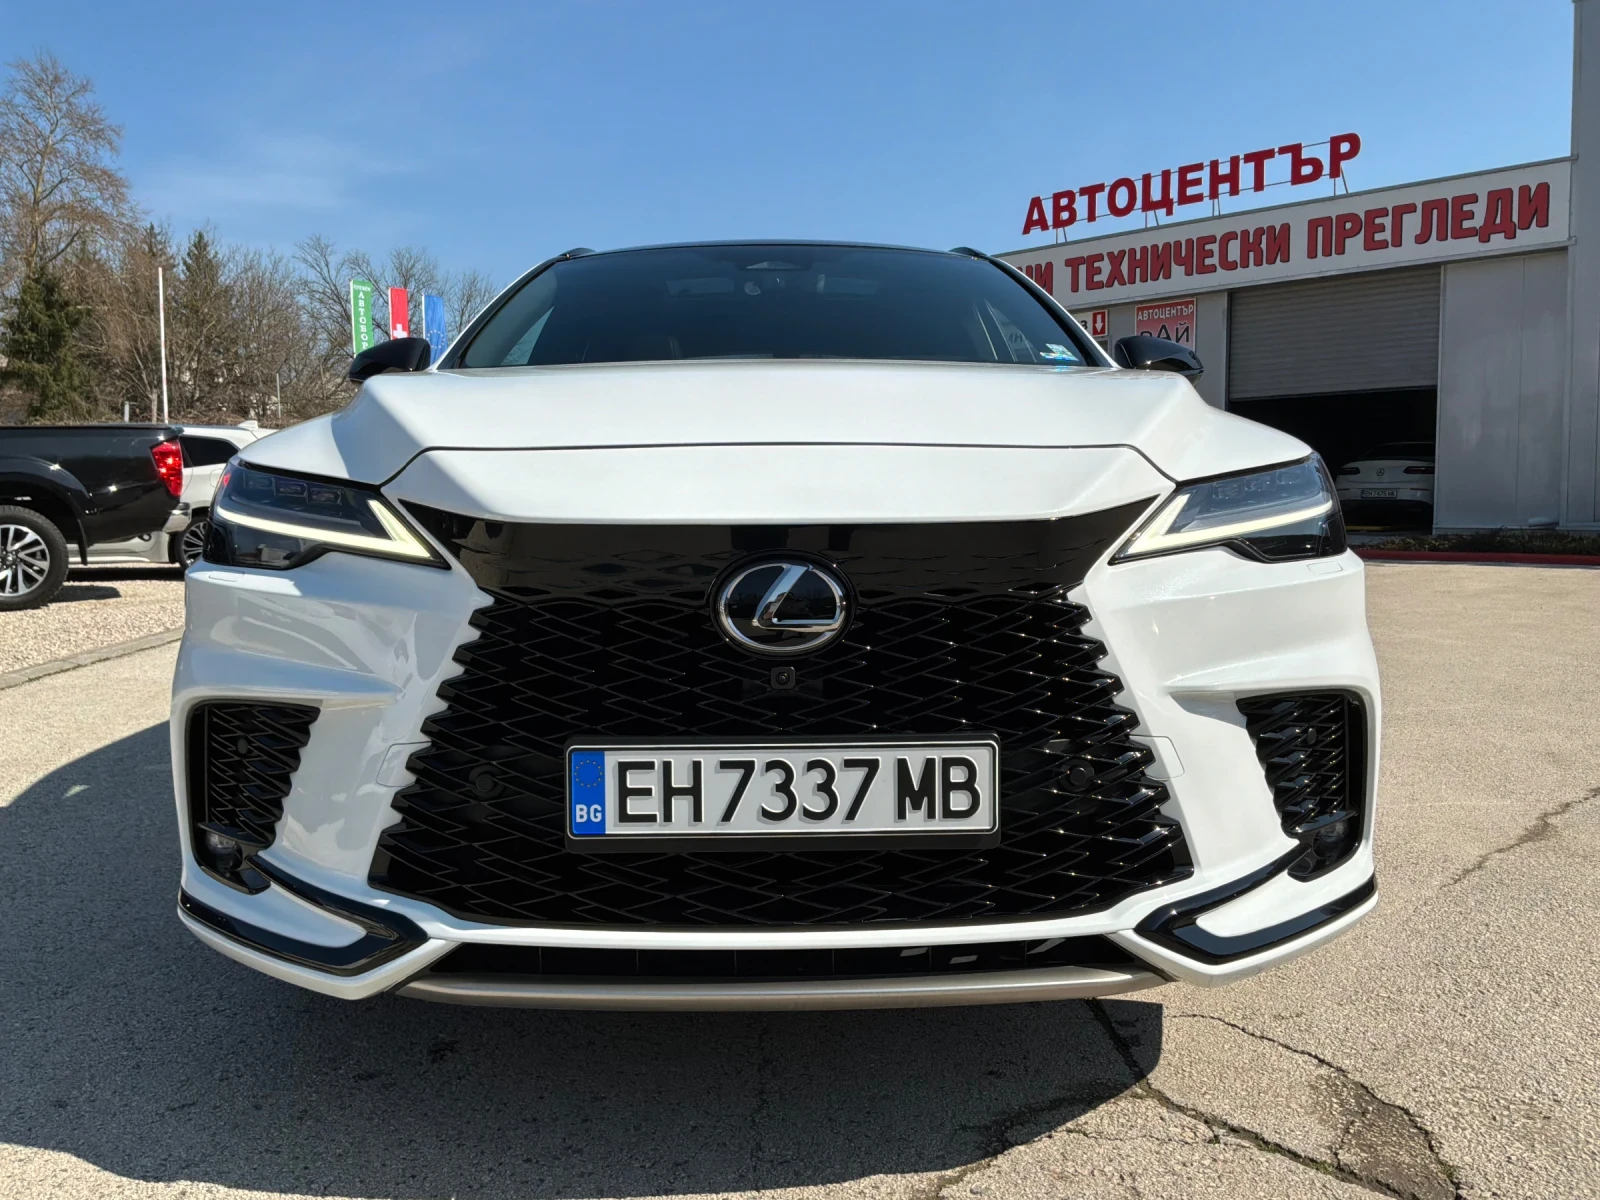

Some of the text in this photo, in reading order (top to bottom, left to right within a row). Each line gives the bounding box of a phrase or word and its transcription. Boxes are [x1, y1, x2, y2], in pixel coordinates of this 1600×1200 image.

[1022, 132, 1361, 235] АВТОЦЕНТЪР
[1065, 222, 1290, 293] ТЕХНИЧЕСКИ
[1307, 182, 1550, 259] ПРЕГЛЕДИ
[1138, 304, 1193, 320] АВТОЦЕНТЪР
[575, 804, 602, 823] BG
[617, 756, 981, 824] EH 7337 MB
